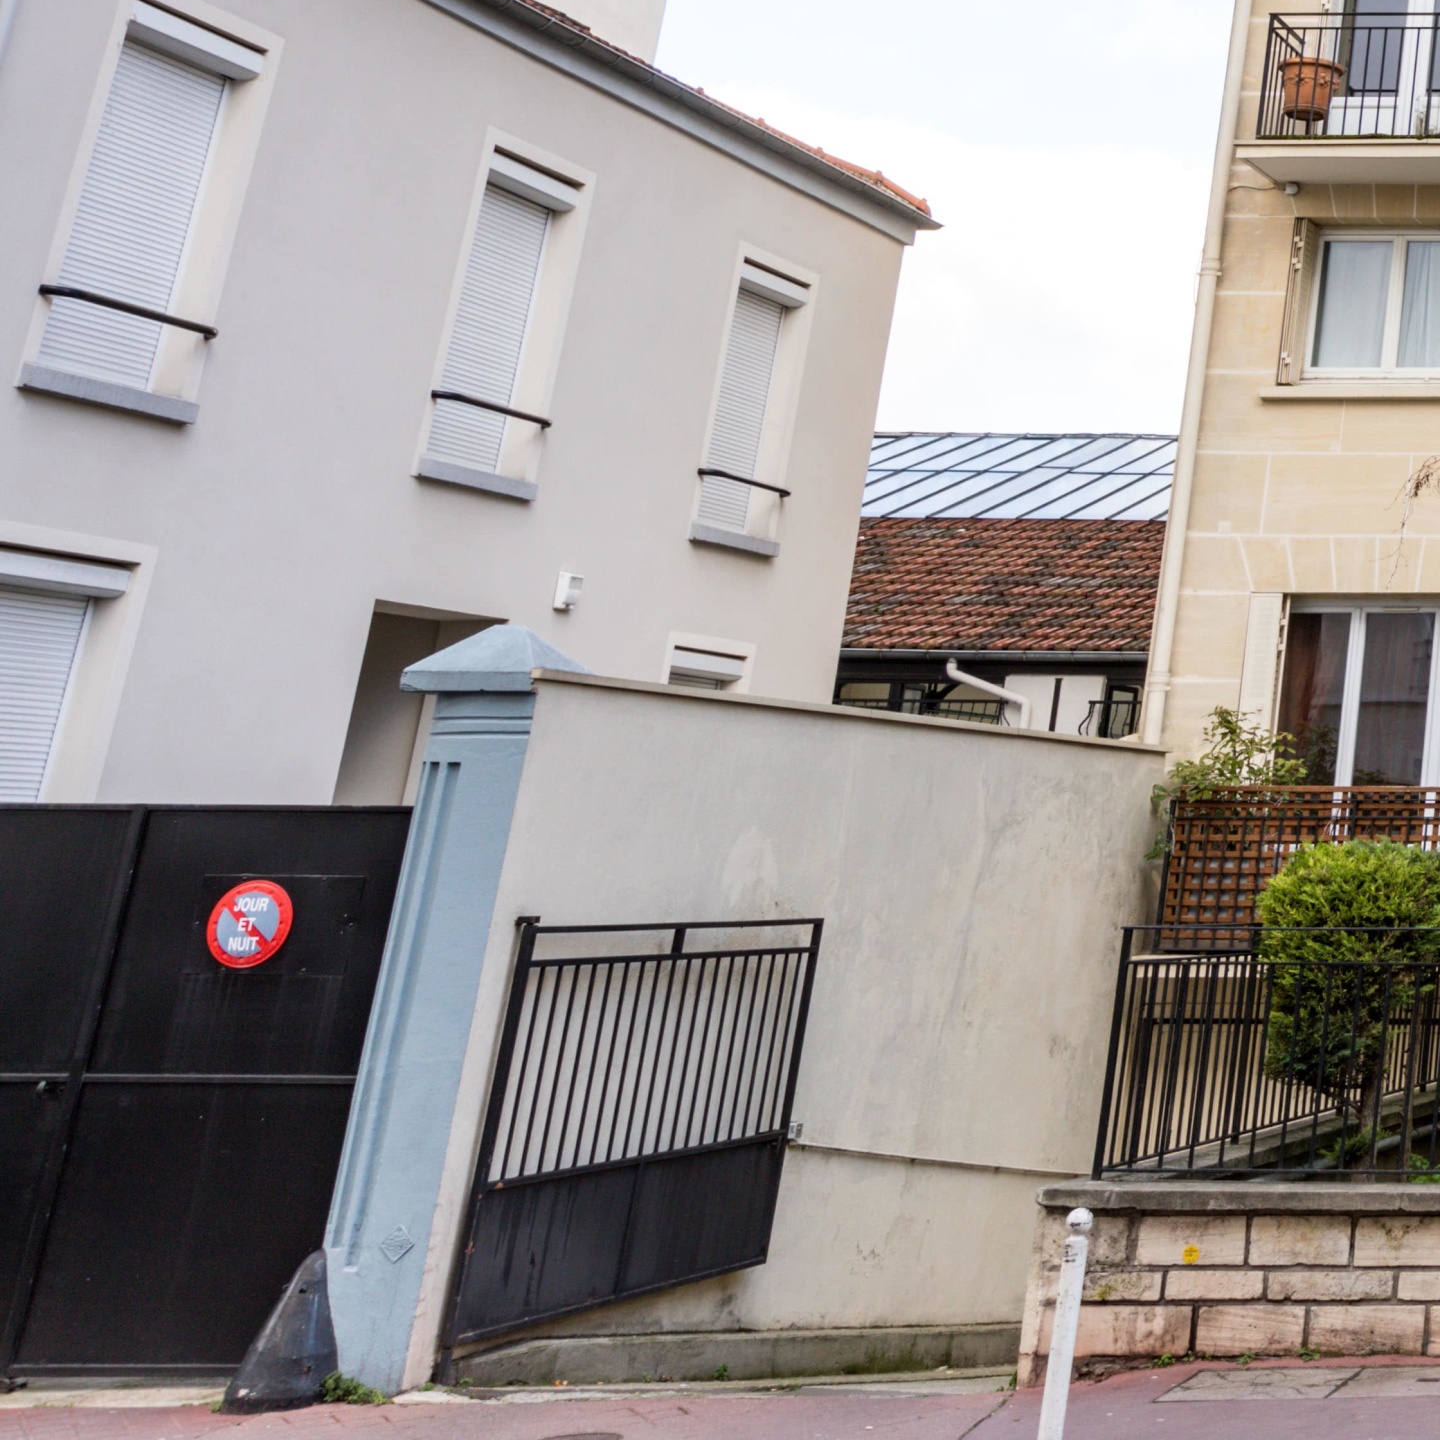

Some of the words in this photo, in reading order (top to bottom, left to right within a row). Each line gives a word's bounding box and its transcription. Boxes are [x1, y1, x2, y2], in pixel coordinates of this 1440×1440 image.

[233, 897, 269, 912] JOUR
[237, 917, 256, 932] ET
[228, 936, 260, 951] NUIT
